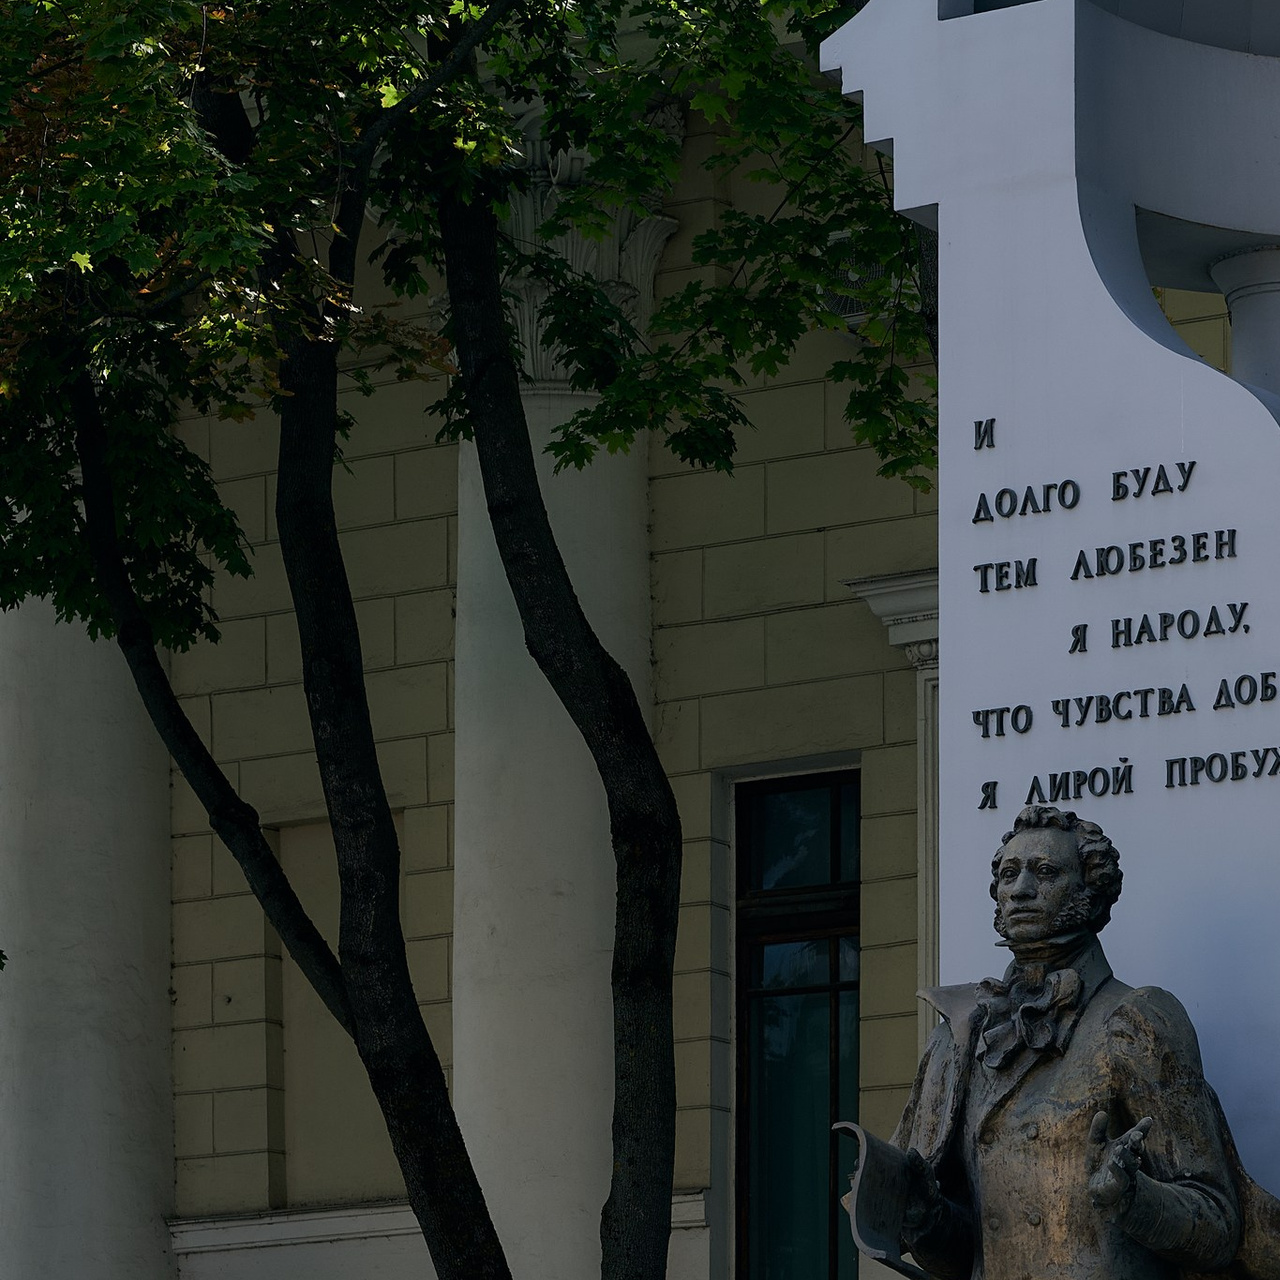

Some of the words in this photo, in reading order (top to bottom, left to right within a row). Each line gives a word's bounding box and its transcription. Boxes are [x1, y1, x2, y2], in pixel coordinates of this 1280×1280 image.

[974, 418, 996, 451] И
[972, 480, 1081, 525] ДОЛГО
[1111, 461, 1197, 502] БУДУ
[973, 558, 1038, 595] ТЕМ
[1070, 529, 1238, 581] ЛЮБЕЗЕН
[1068, 624, 1089, 654] Я
[1111, 602, 1250, 650] НАРОДУ,
[972, 705, 1034, 739] ЧТО
[1051, 683, 1196, 728] ЧУВСТВА
[978, 781, 999, 810] Я
[1025, 757, 1134, 805] ЛИРОЙ
